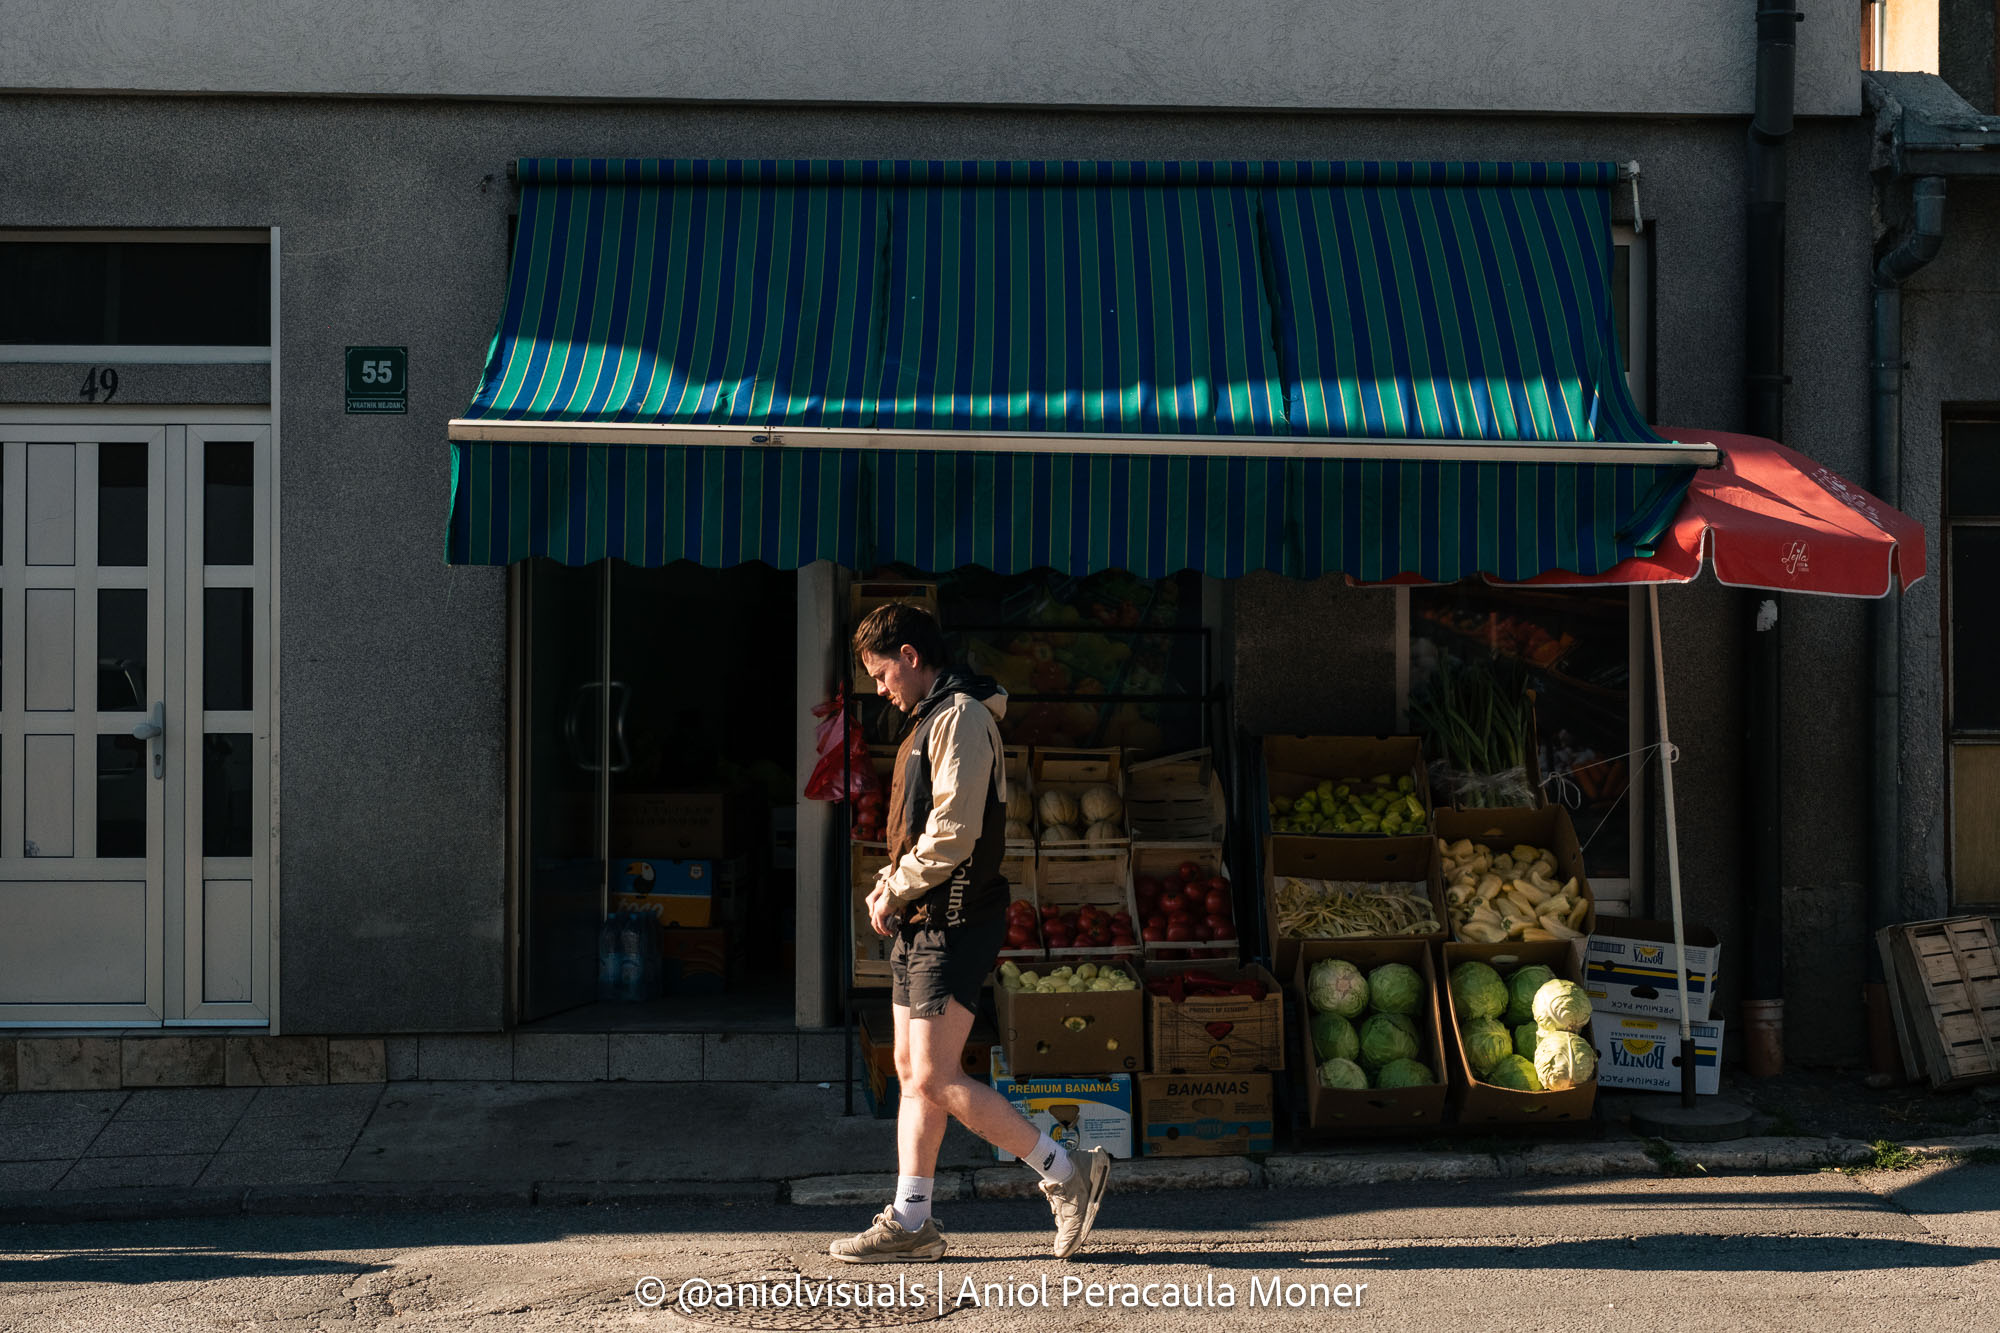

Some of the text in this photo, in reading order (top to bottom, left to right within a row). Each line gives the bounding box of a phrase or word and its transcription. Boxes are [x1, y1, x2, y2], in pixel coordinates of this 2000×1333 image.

[362, 360, 393, 384] 55
[80, 367, 118, 403] 49
[1633, 948, 1664, 965] BONITA
[1611, 1001, 1674, 1014] PREMIUM PACK
[1610, 1041, 1666, 1070] BONITA
[1008, 1082, 1120, 1094] PREMIUM BANANAS
[1599, 1074, 1670, 1087] PREMIUM PACK
[1167, 1081, 1250, 1097] BANANAS
